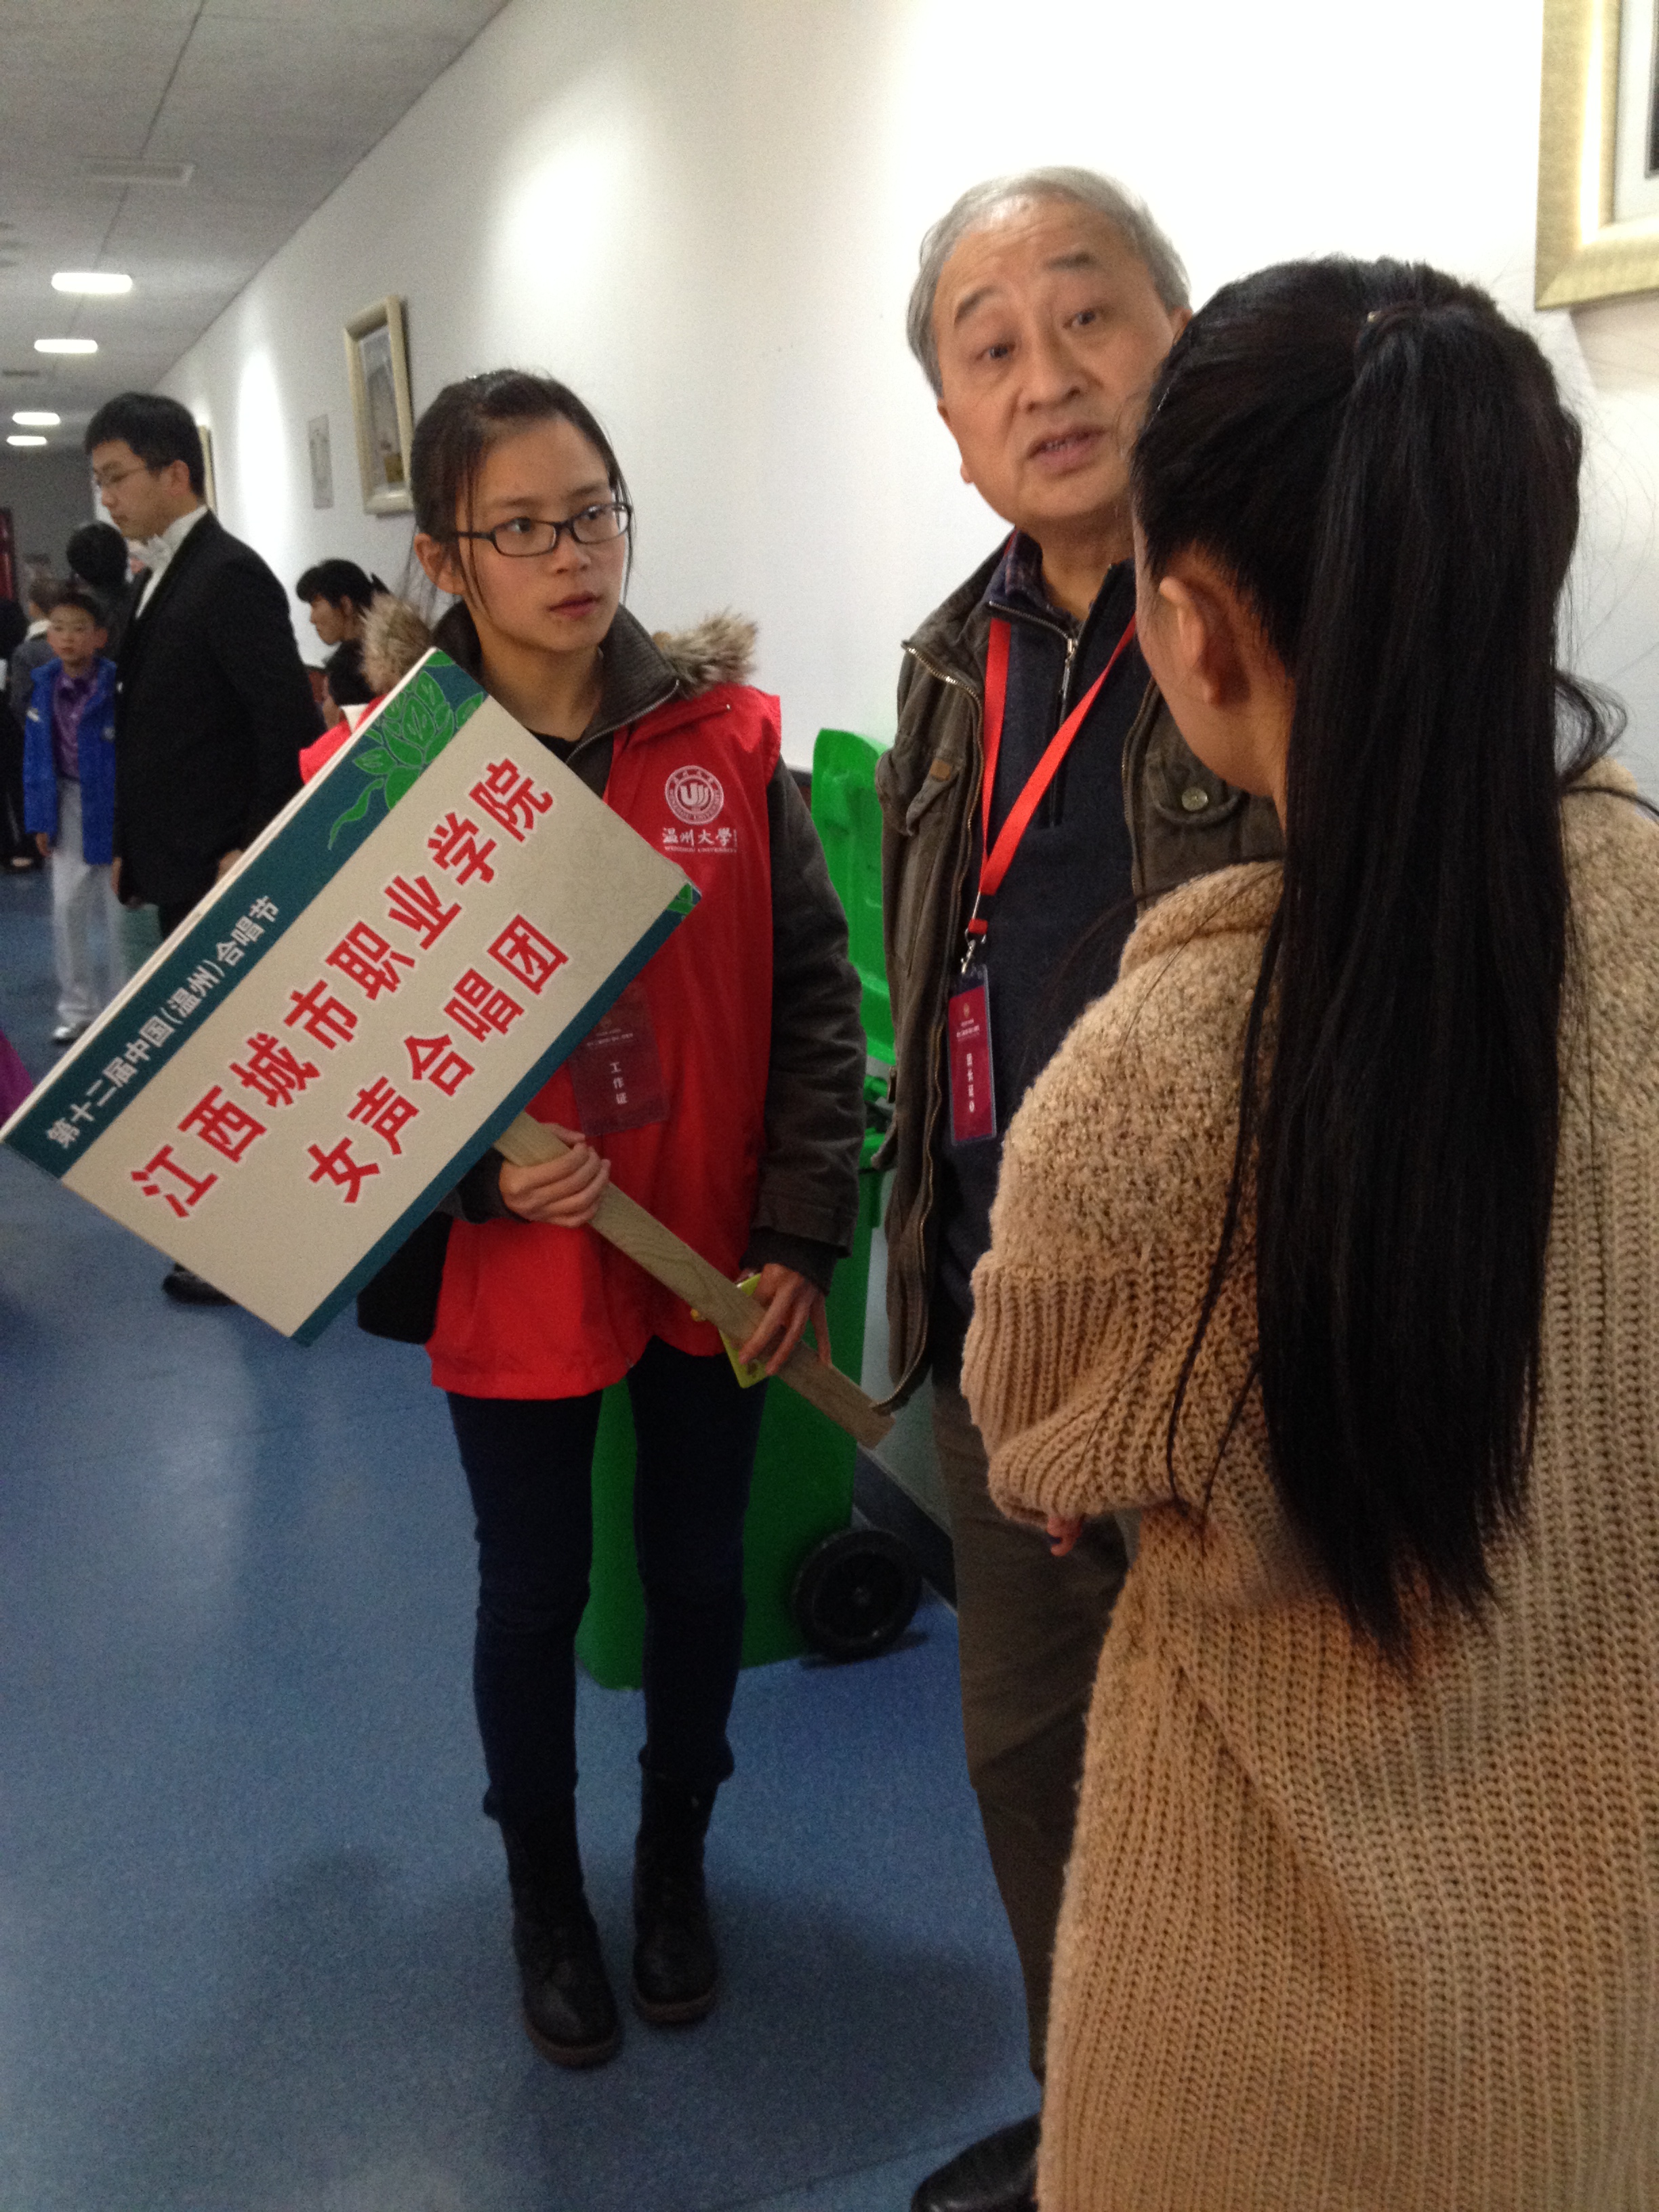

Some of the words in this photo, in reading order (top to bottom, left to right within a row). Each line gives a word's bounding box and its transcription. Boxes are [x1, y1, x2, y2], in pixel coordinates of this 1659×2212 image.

[131, 758, 554, 1217] 江西城市职业学院
[307, 914, 569, 1202] 女声合唱团
